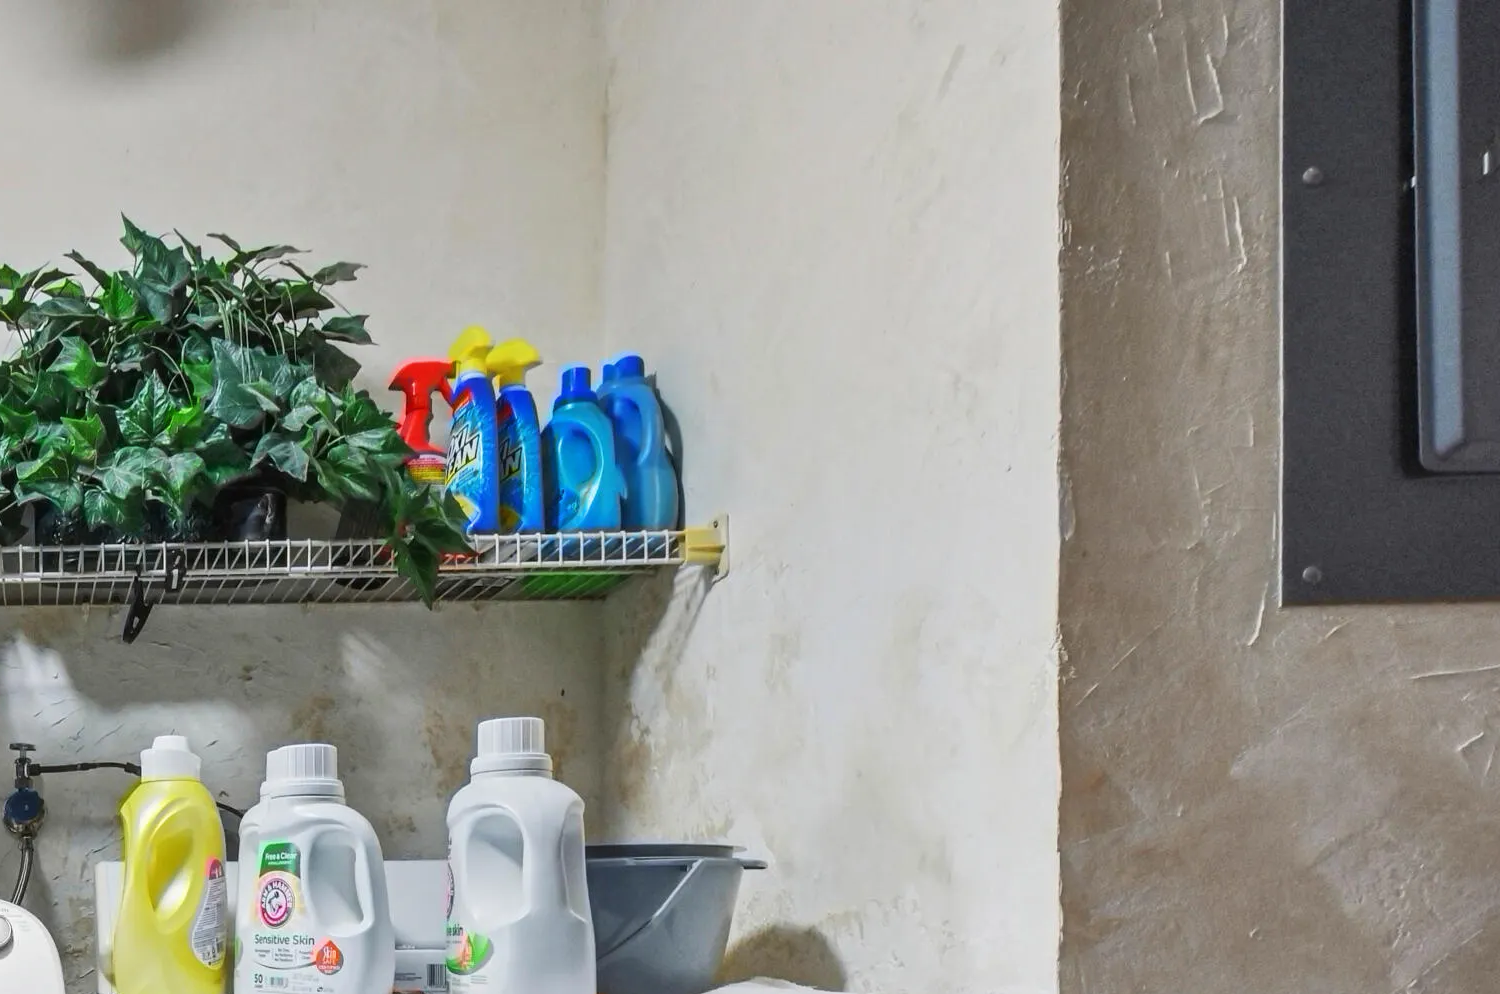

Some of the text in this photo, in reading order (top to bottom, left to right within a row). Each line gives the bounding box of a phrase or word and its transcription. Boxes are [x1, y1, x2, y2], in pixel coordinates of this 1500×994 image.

[446, 434, 479, 481] EAN
[265, 852, 276, 860] Free
[281, 852, 297, 860] Clear
[255, 934, 315, 946] Sensitive Skin
[323, 947, 336, 959] Skin
[254, 973, 263, 983] 50
